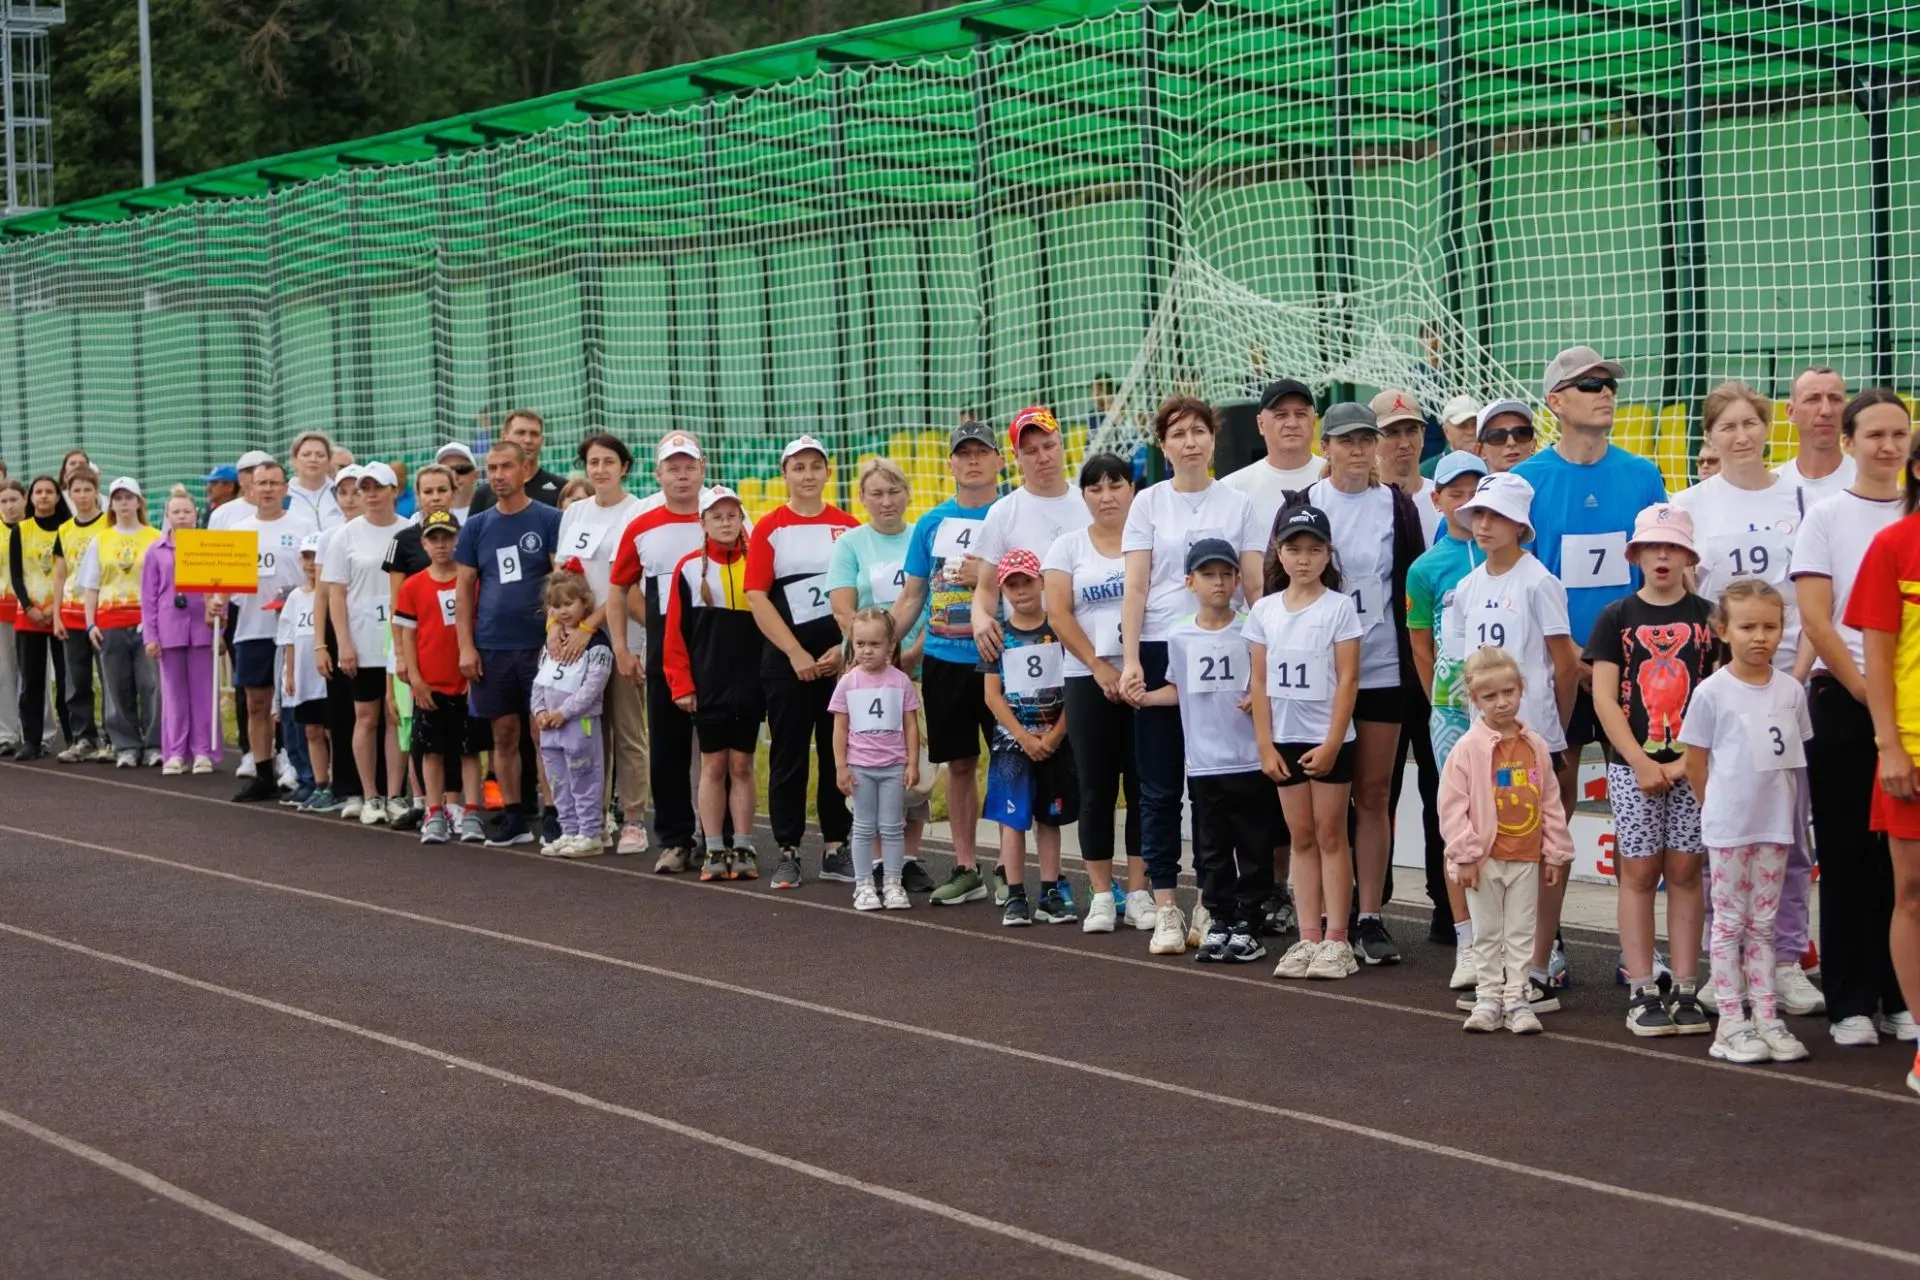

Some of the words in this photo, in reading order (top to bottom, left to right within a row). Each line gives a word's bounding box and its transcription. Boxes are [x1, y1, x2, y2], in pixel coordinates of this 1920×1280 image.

[575, 532, 591, 550] 5
[956, 528, 972, 549] 4
[503, 556, 515, 575] 9
[1588, 548, 1606, 575] 7
[1729, 545, 1769, 577] 19
[445, 598, 456, 617] 9
[808, 586, 826, 608] 2
[1477, 623, 1505, 649] 19
[552, 662, 566, 681] 5
[1026, 655, 1043, 678] 8
[1199, 655, 1235, 681] 21
[1278, 662, 1310, 689] 11
[868, 697, 884, 719] 4
[1769, 726, 1785, 756] 3
